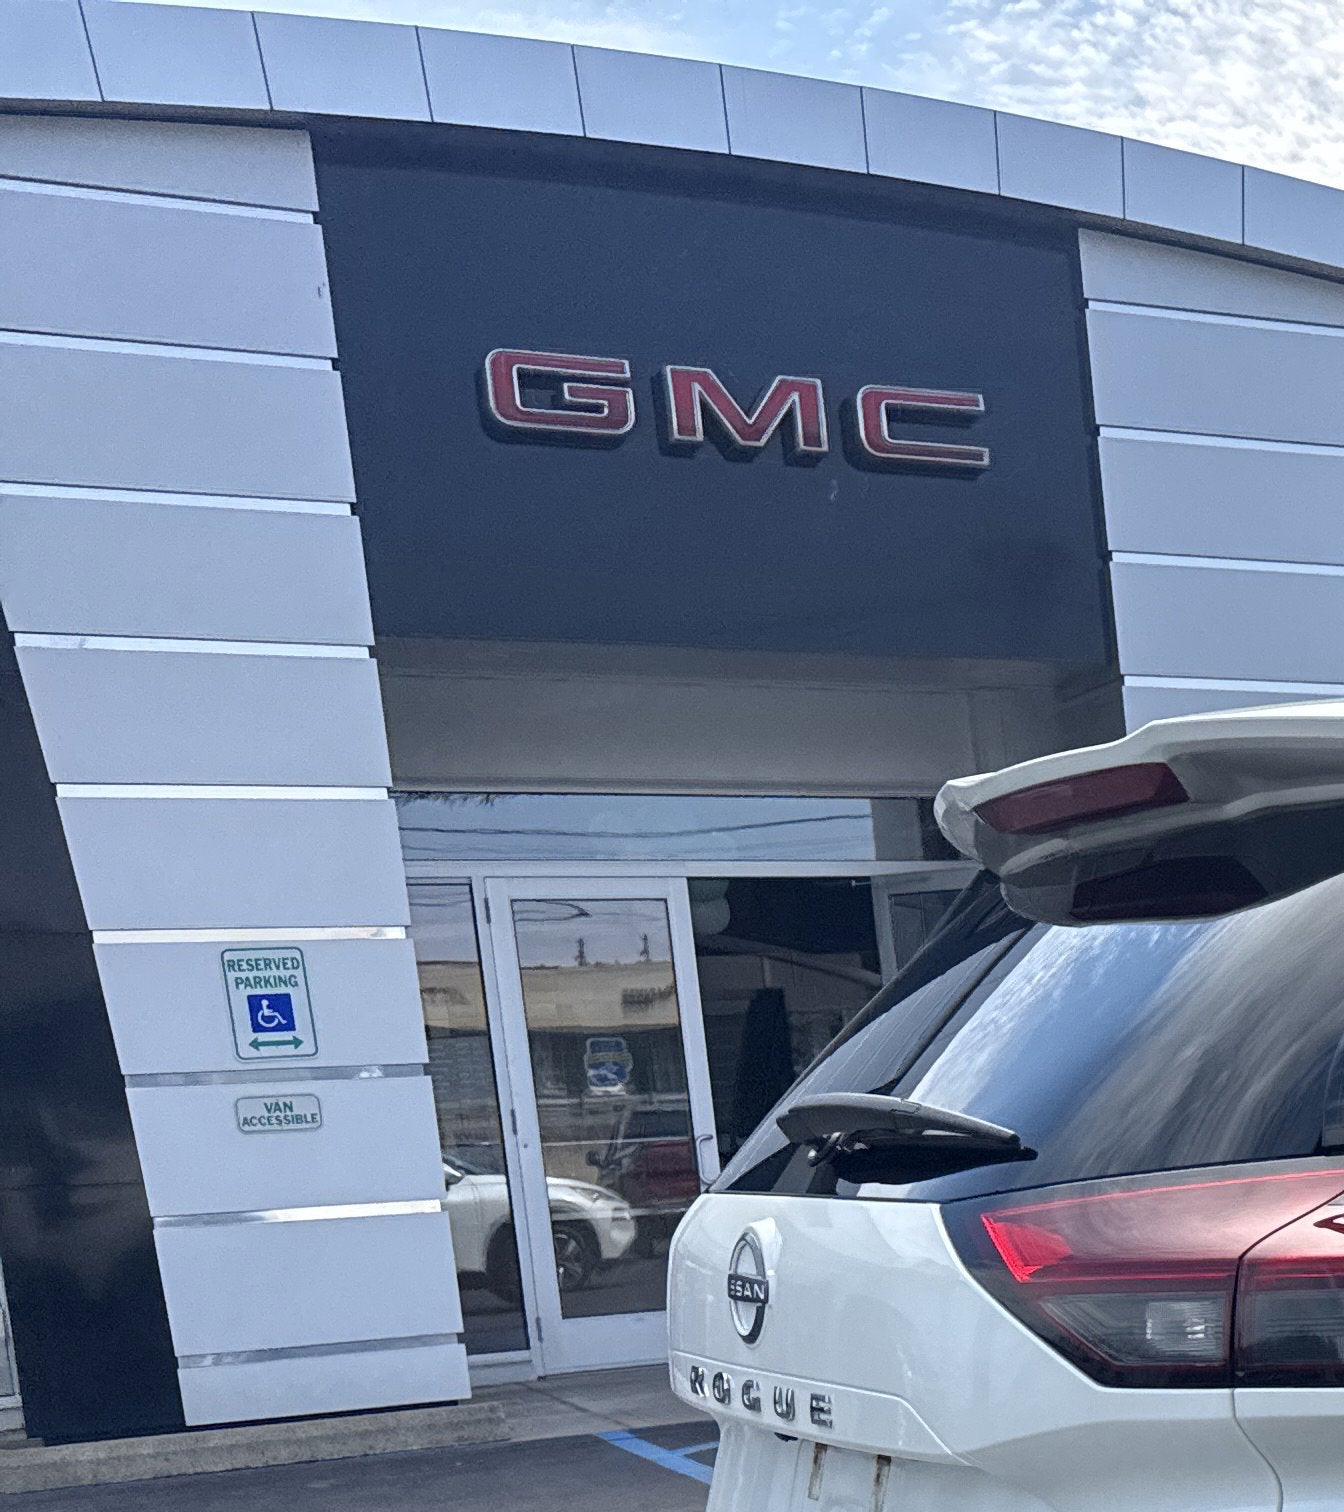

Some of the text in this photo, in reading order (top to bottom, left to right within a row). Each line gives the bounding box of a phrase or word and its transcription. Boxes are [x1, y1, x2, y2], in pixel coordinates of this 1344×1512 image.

[484, 347, 990, 466] GMC
[226, 956, 301, 973] RESERVED
[234, 974, 299, 990] PARKING
[263, 1101, 294, 1114] VAN
[241, 1113, 320, 1127] ACCESSIBLE
[689, 1364, 834, 1429] ROGUE
